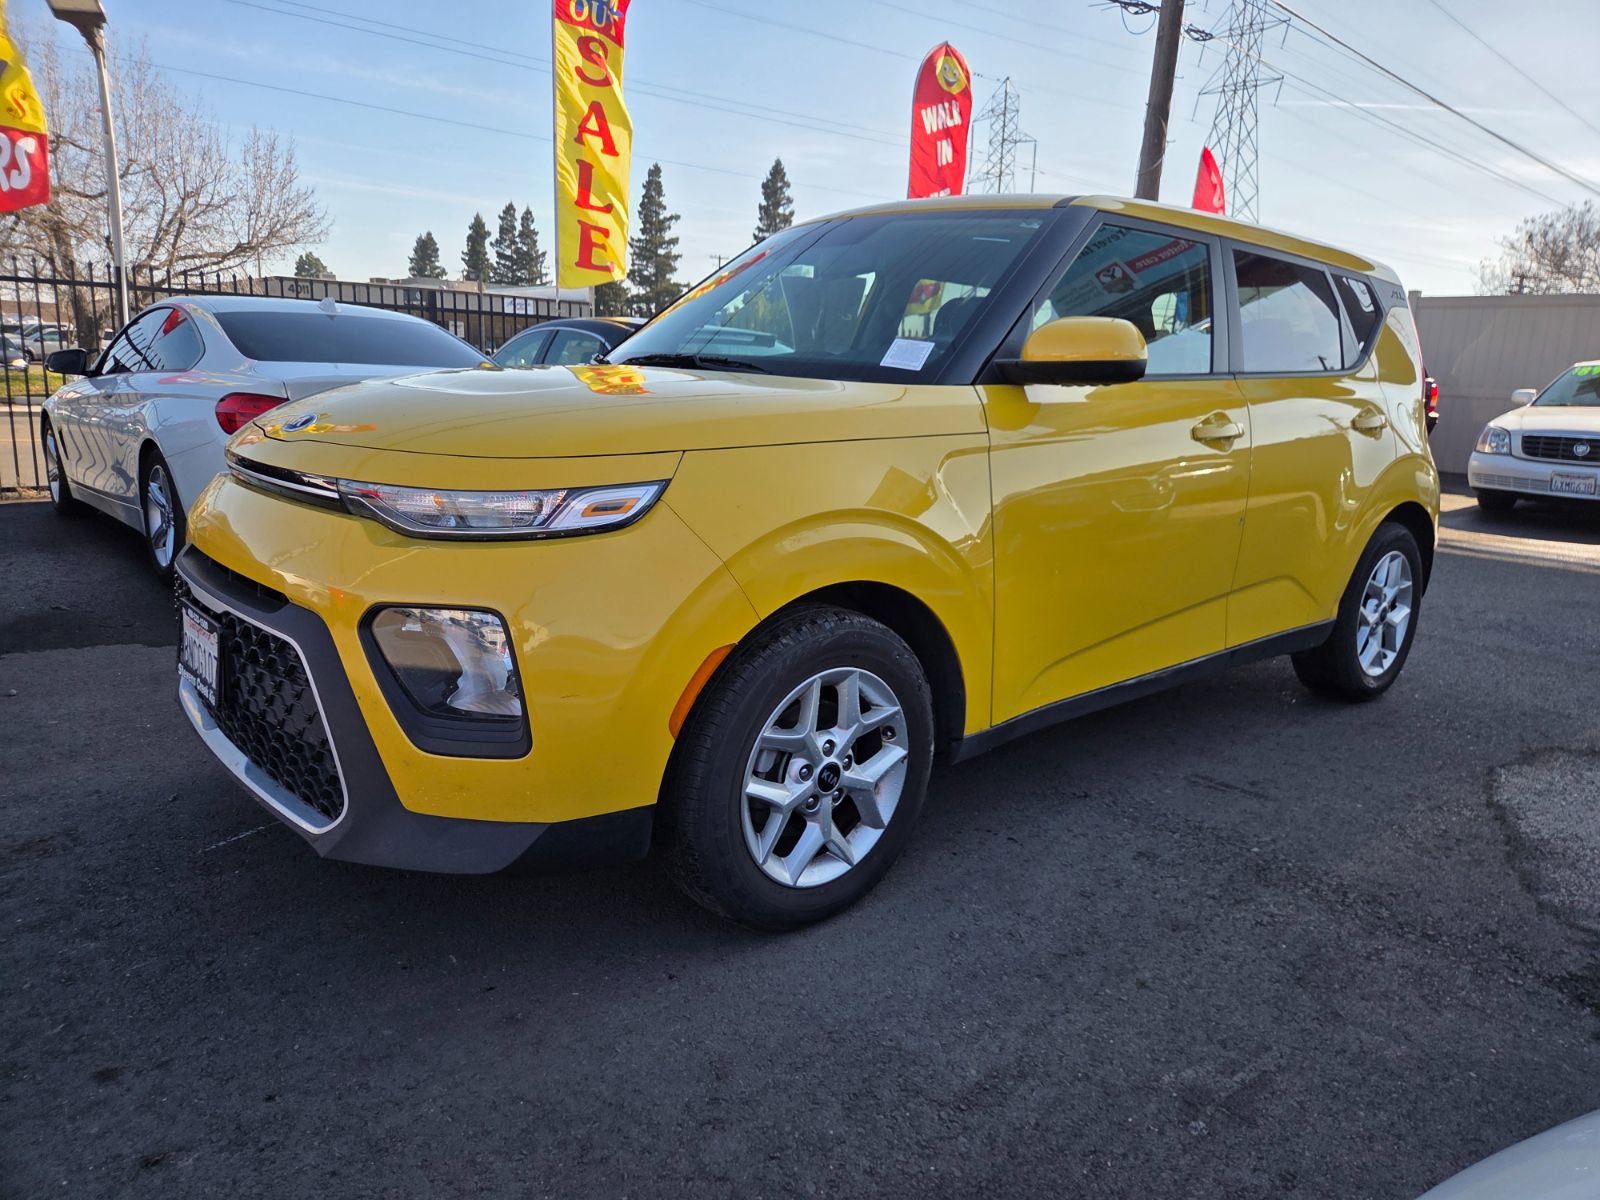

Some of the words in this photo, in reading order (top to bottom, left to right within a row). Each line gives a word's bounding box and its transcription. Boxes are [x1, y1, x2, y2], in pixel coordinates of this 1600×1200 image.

[921, 100, 963, 135] WALK
[574, 35, 620, 273] SALE
[936, 138, 953, 168] IN
[821, 769, 838, 786] KIA
